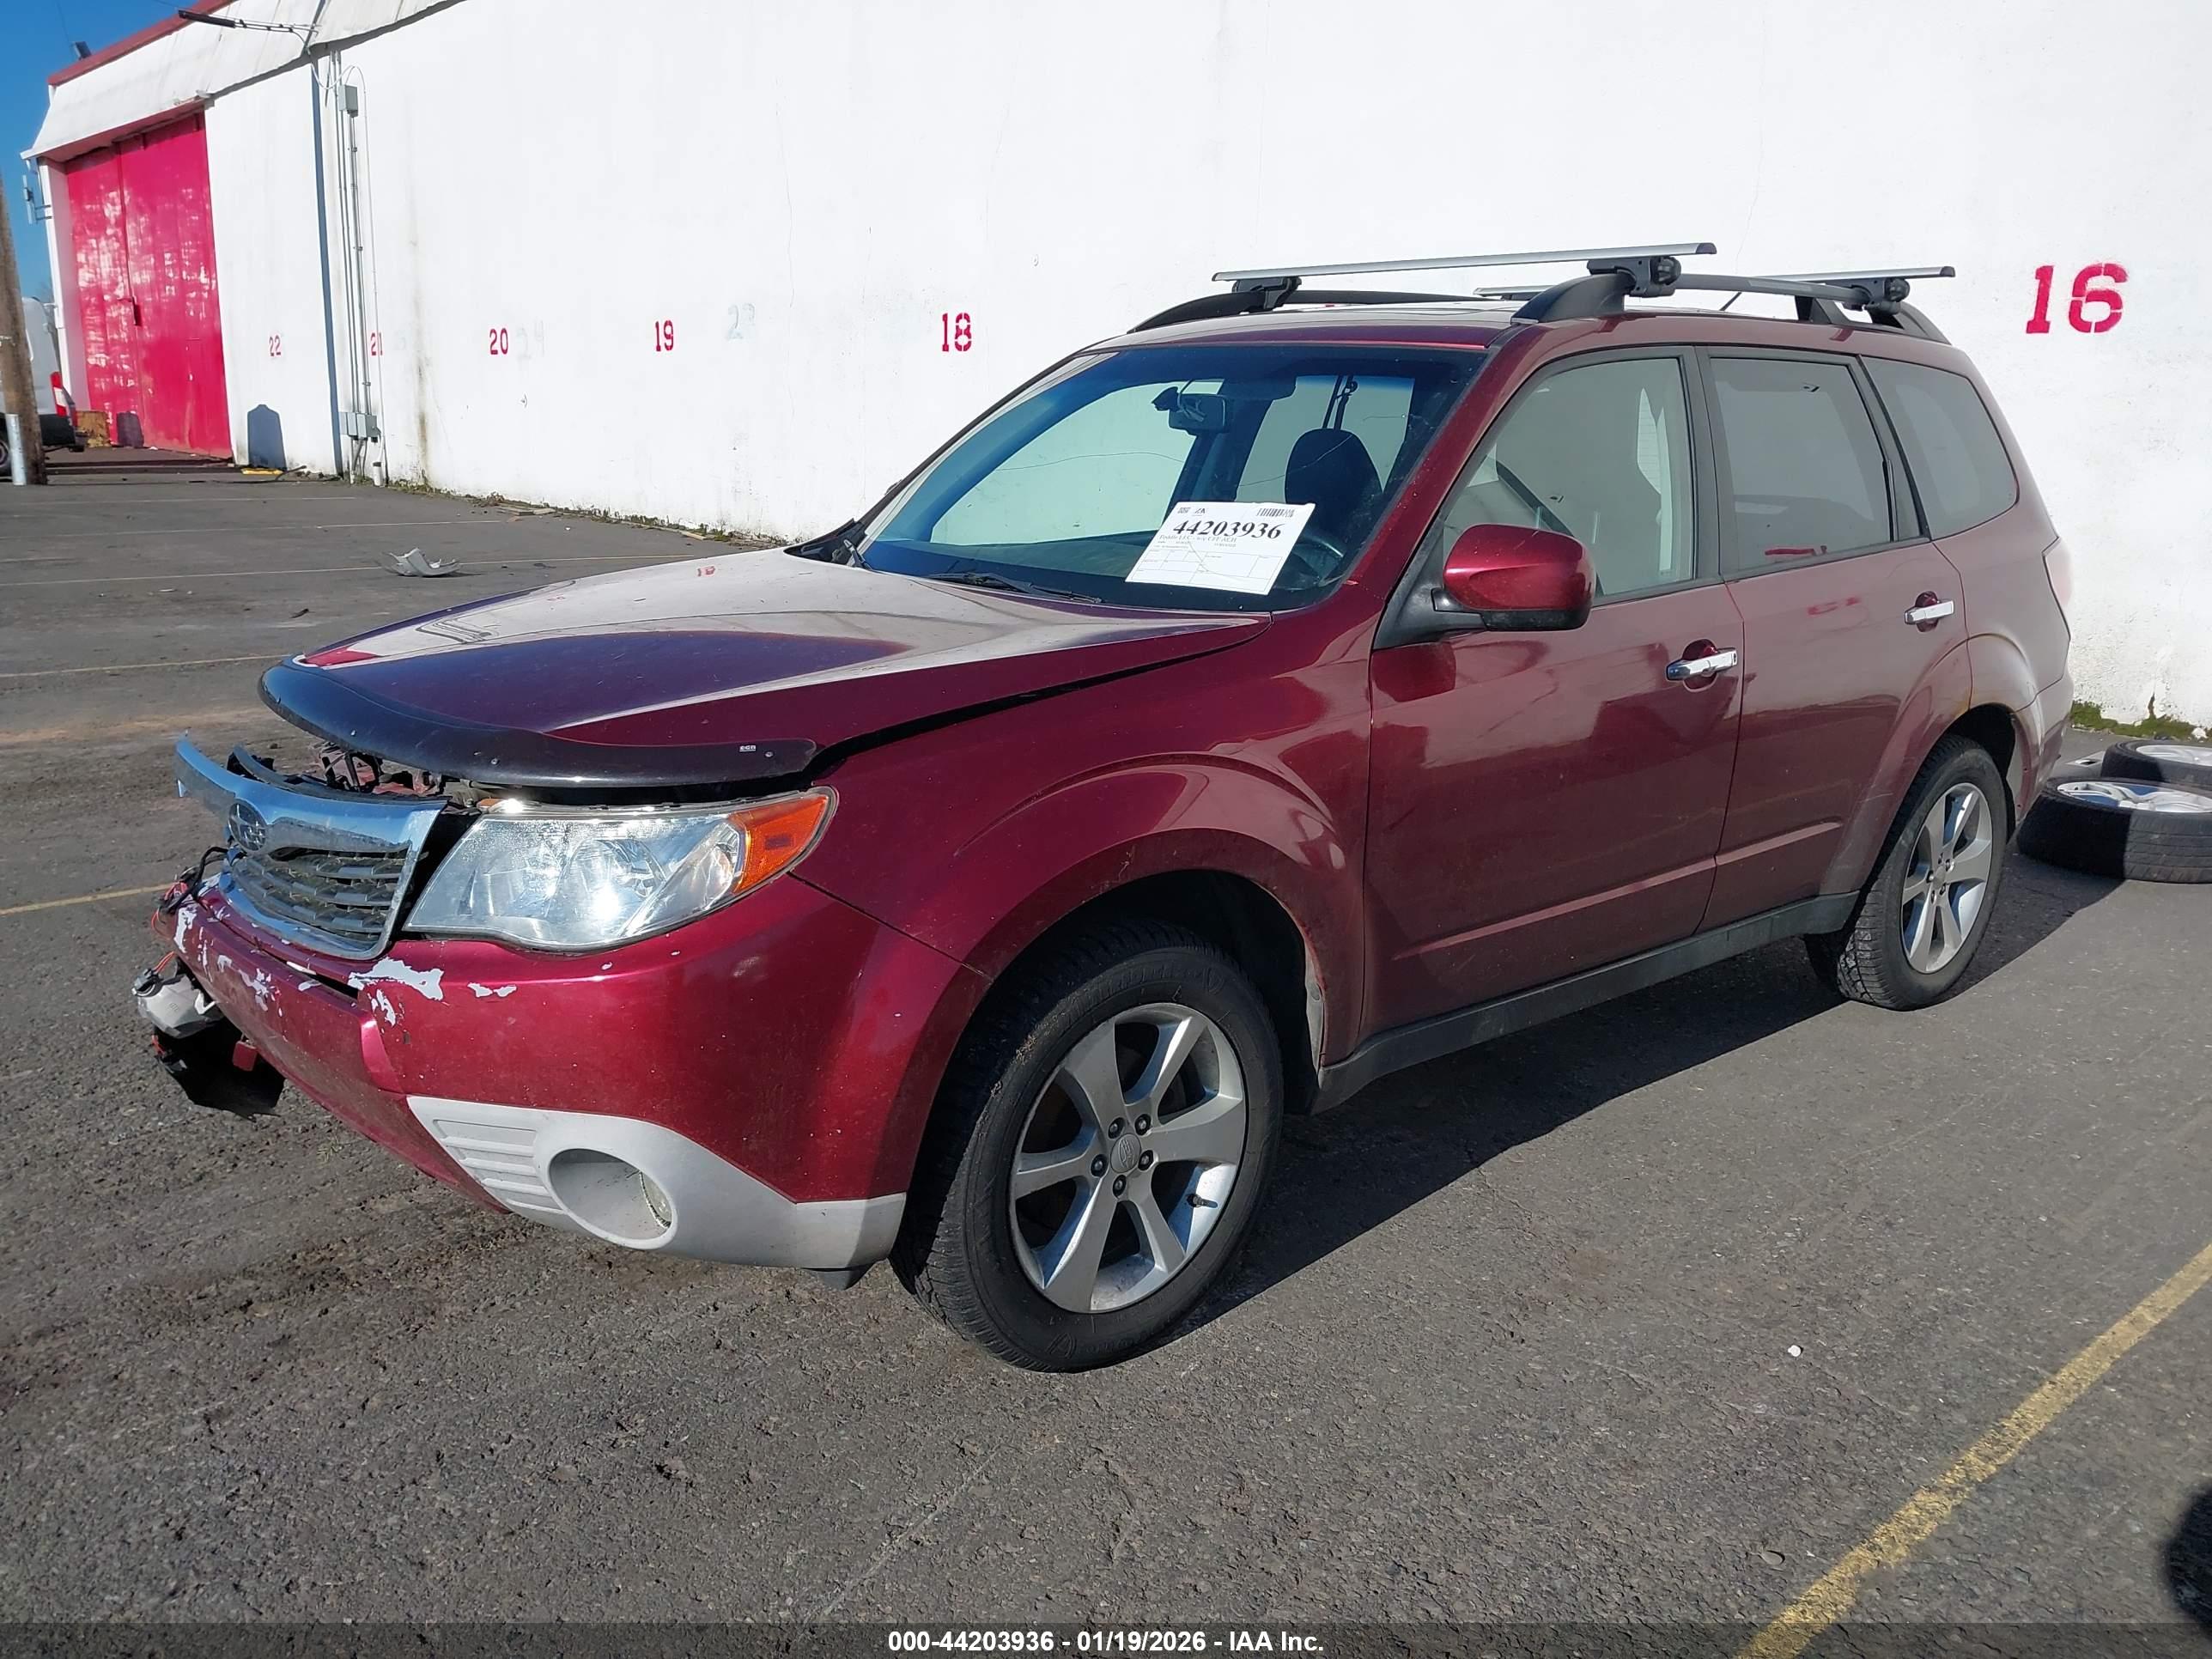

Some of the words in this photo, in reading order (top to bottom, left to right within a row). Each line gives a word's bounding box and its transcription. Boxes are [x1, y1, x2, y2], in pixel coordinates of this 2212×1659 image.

[2026, 263, 2129, 334] 16
[269, 335, 282, 357] 22
[370, 331, 383, 356] 21
[489, 328, 508, 356] 20
[655, 319, 674, 351] 19
[942, 313, 972, 352] 18
[1173, 520, 1285, 539] 44203936
